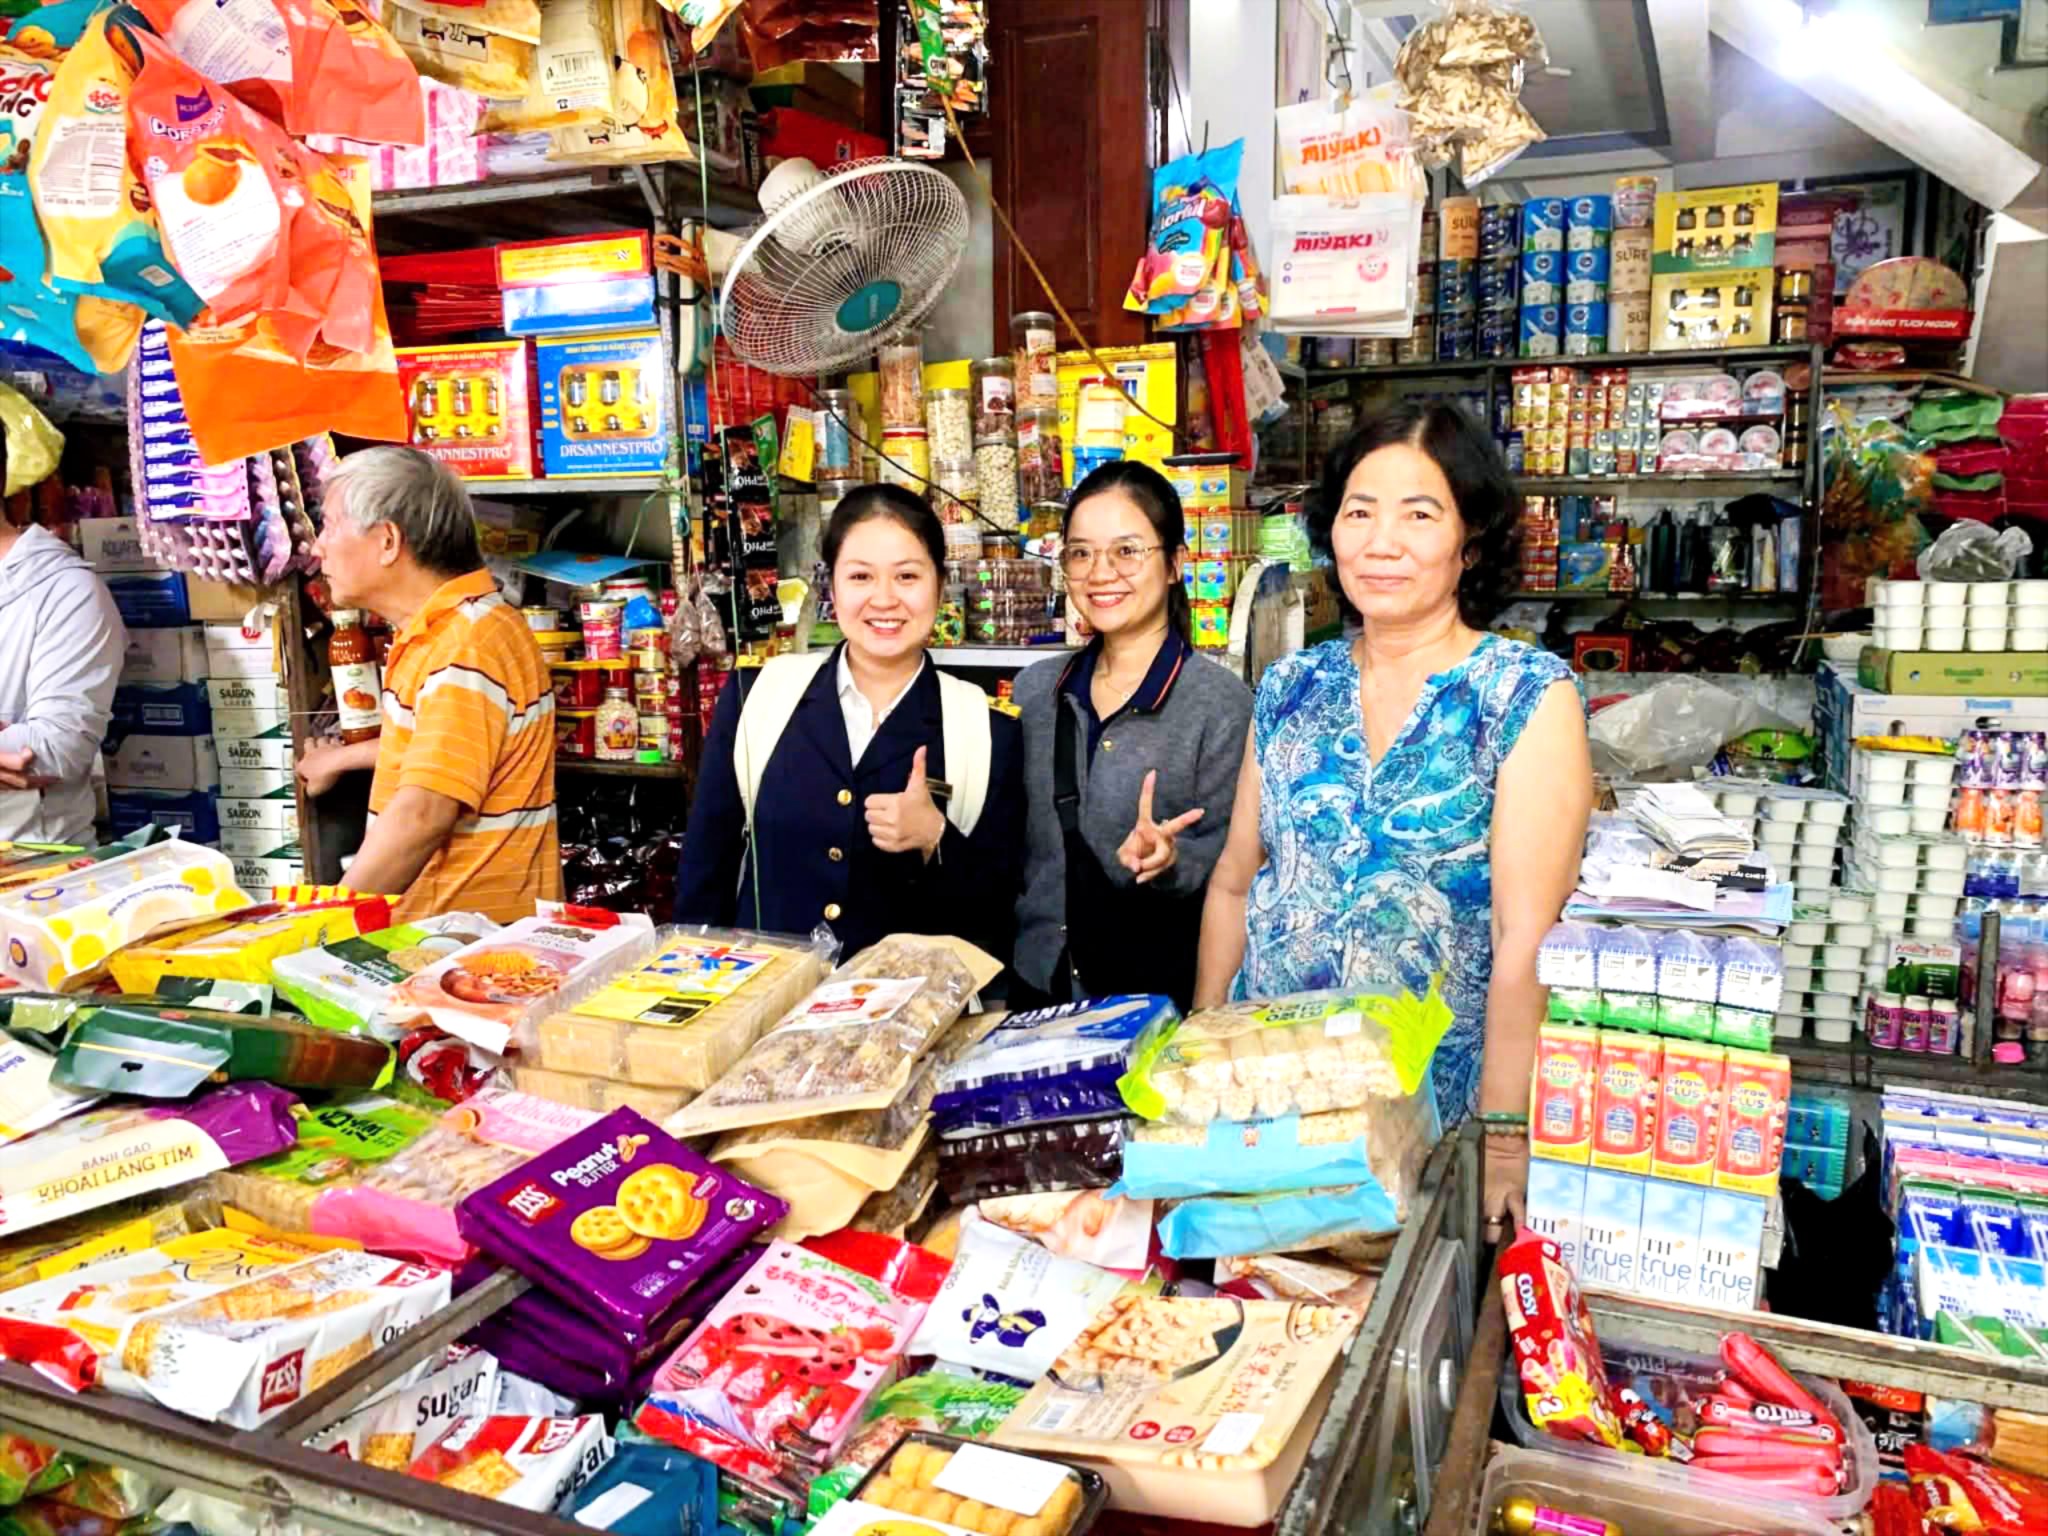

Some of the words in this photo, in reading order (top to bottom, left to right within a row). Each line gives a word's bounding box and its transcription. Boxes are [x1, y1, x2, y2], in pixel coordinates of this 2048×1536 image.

[1301, 127, 1381, 164] MIYAKI
[1292, 234, 1373, 253] MIYAKI
[219, 688, 255, 699] SAIGON
[228, 747, 261, 758] SAIGON
[227, 807, 261, 818] SAIGON
[104, 1155, 155, 1183] LANG
[159, 1145, 193, 1167] TÍM
[550, 1142, 618, 1187] Peanut
[578, 1160, 620, 1188] BUTTER
[508, 1183, 549, 1220] ZESS
[1528, 1216, 1556, 1235] TH
[1585, 1226, 1612, 1245] TH
[1583, 1241, 1633, 1270] true
[1643, 1237, 1671, 1256] TH
[1702, 1247, 1731, 1267] TH
[1582, 1261, 1632, 1287] MILK
[1641, 1252, 1692, 1280] true
[1700, 1263, 1753, 1291] true
[1517, 1273, 1539, 1317] COSY
[1640, 1272, 1690, 1296] MILK
[1699, 1283, 1750, 1306] MILK
[264, 1355, 301, 1399] ZESS
[416, 1368, 487, 1427] Sugar
[554, 1438, 610, 1505] Sugar
